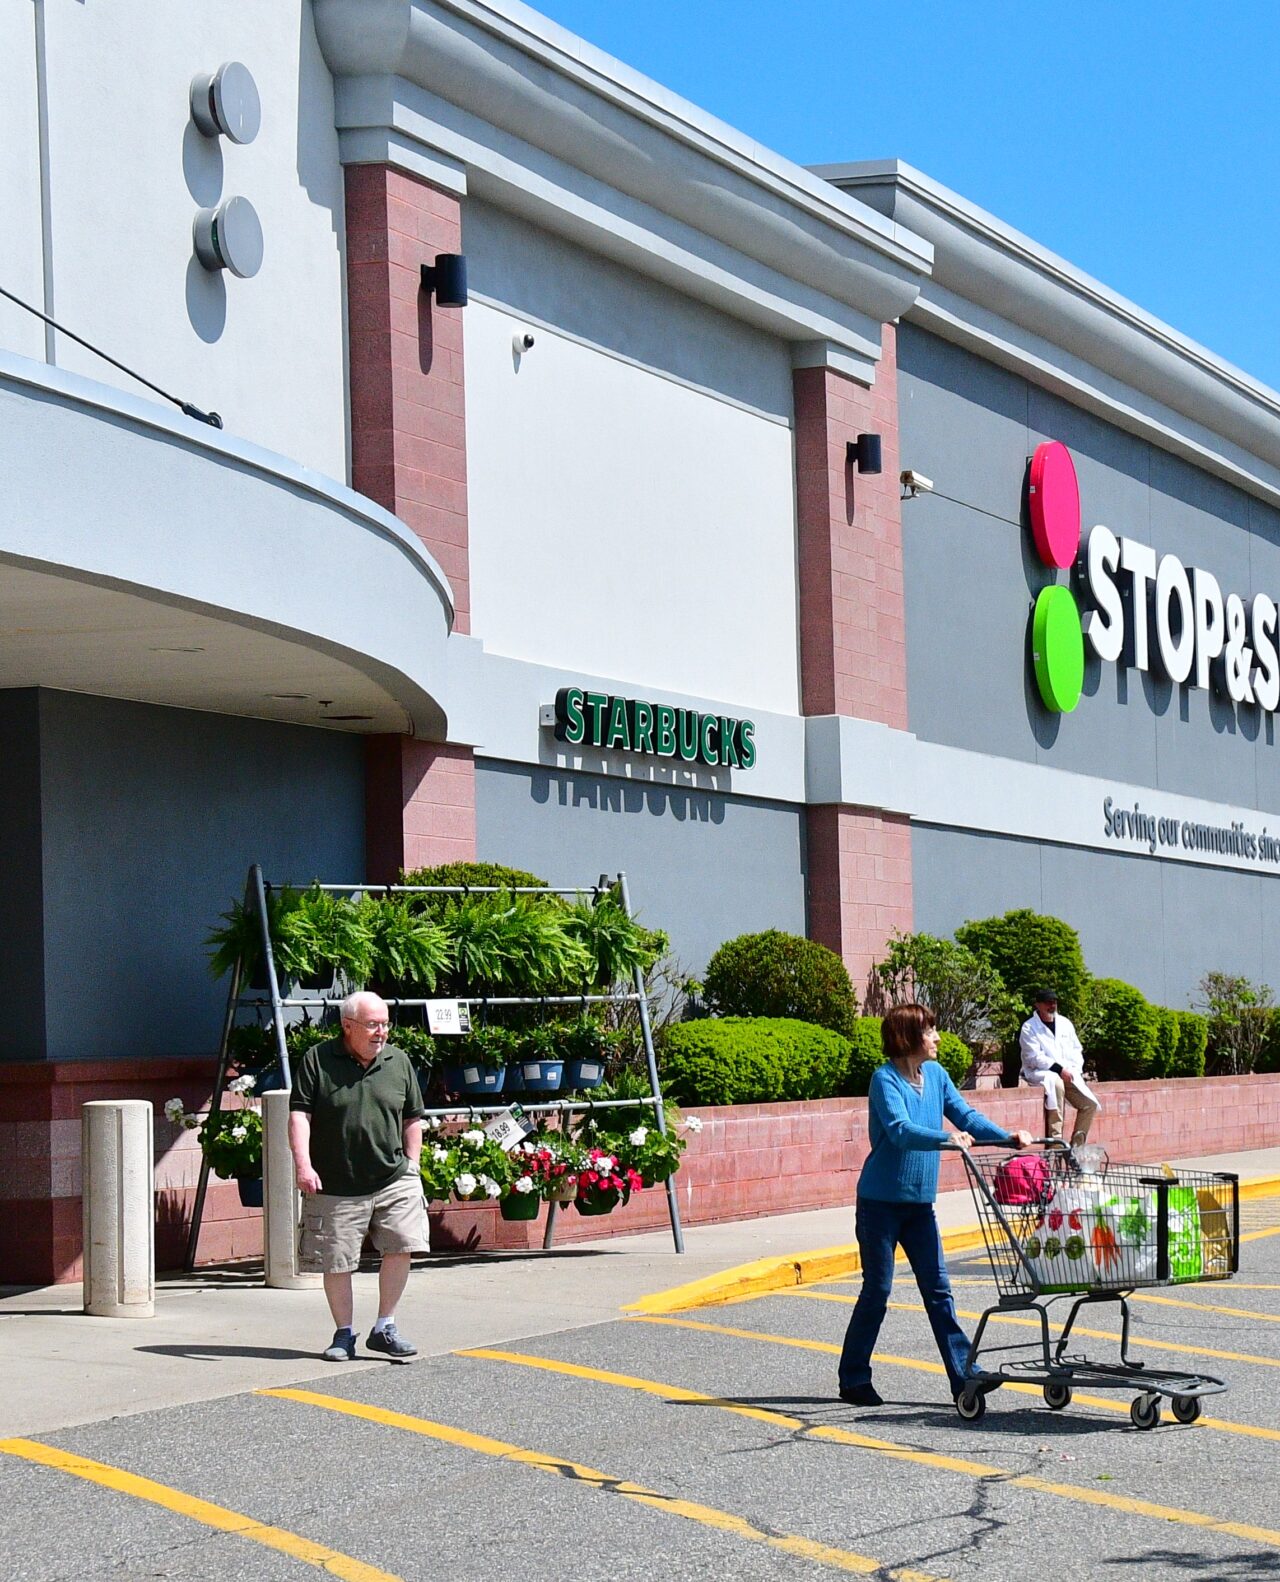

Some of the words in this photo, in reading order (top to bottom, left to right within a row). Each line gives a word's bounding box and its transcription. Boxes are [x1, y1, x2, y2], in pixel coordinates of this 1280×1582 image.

[557, 687, 757, 770] STARBUCKS
[1103, 796, 1157, 854] Serving
[1158, 815, 1180, 848] our
[1181, 820, 1257, 861] communities
[435, 1008, 452, 1021] 22.99
[490, 1121, 511, 1141] 18.99
